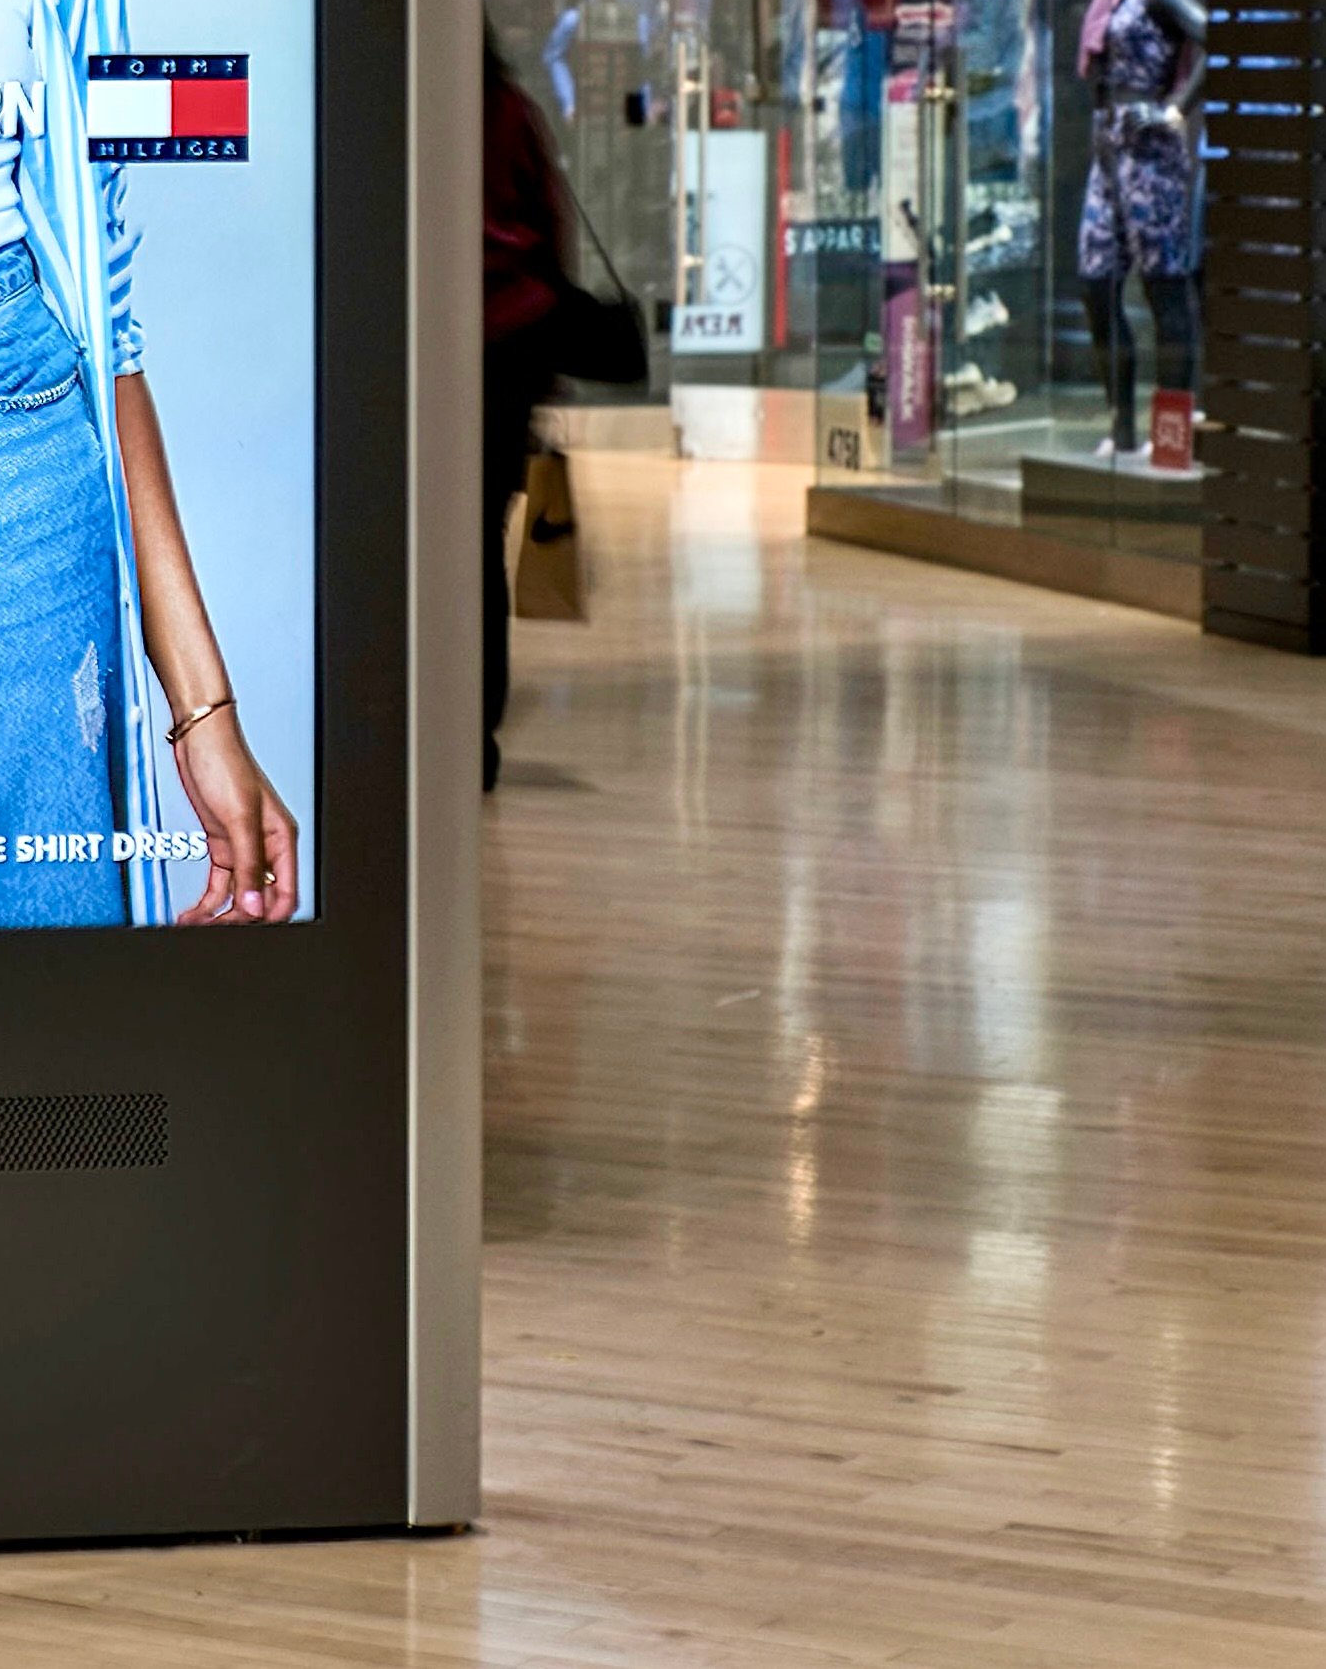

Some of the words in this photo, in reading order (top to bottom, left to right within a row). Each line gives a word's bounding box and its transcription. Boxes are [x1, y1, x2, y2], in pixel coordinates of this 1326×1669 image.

[103, 58, 237, 76] TOMMY
[100, 141, 238, 158] HILFIGER
[15, 833, 104, 863] SHIRT
[112, 831, 210, 862] DRESS
